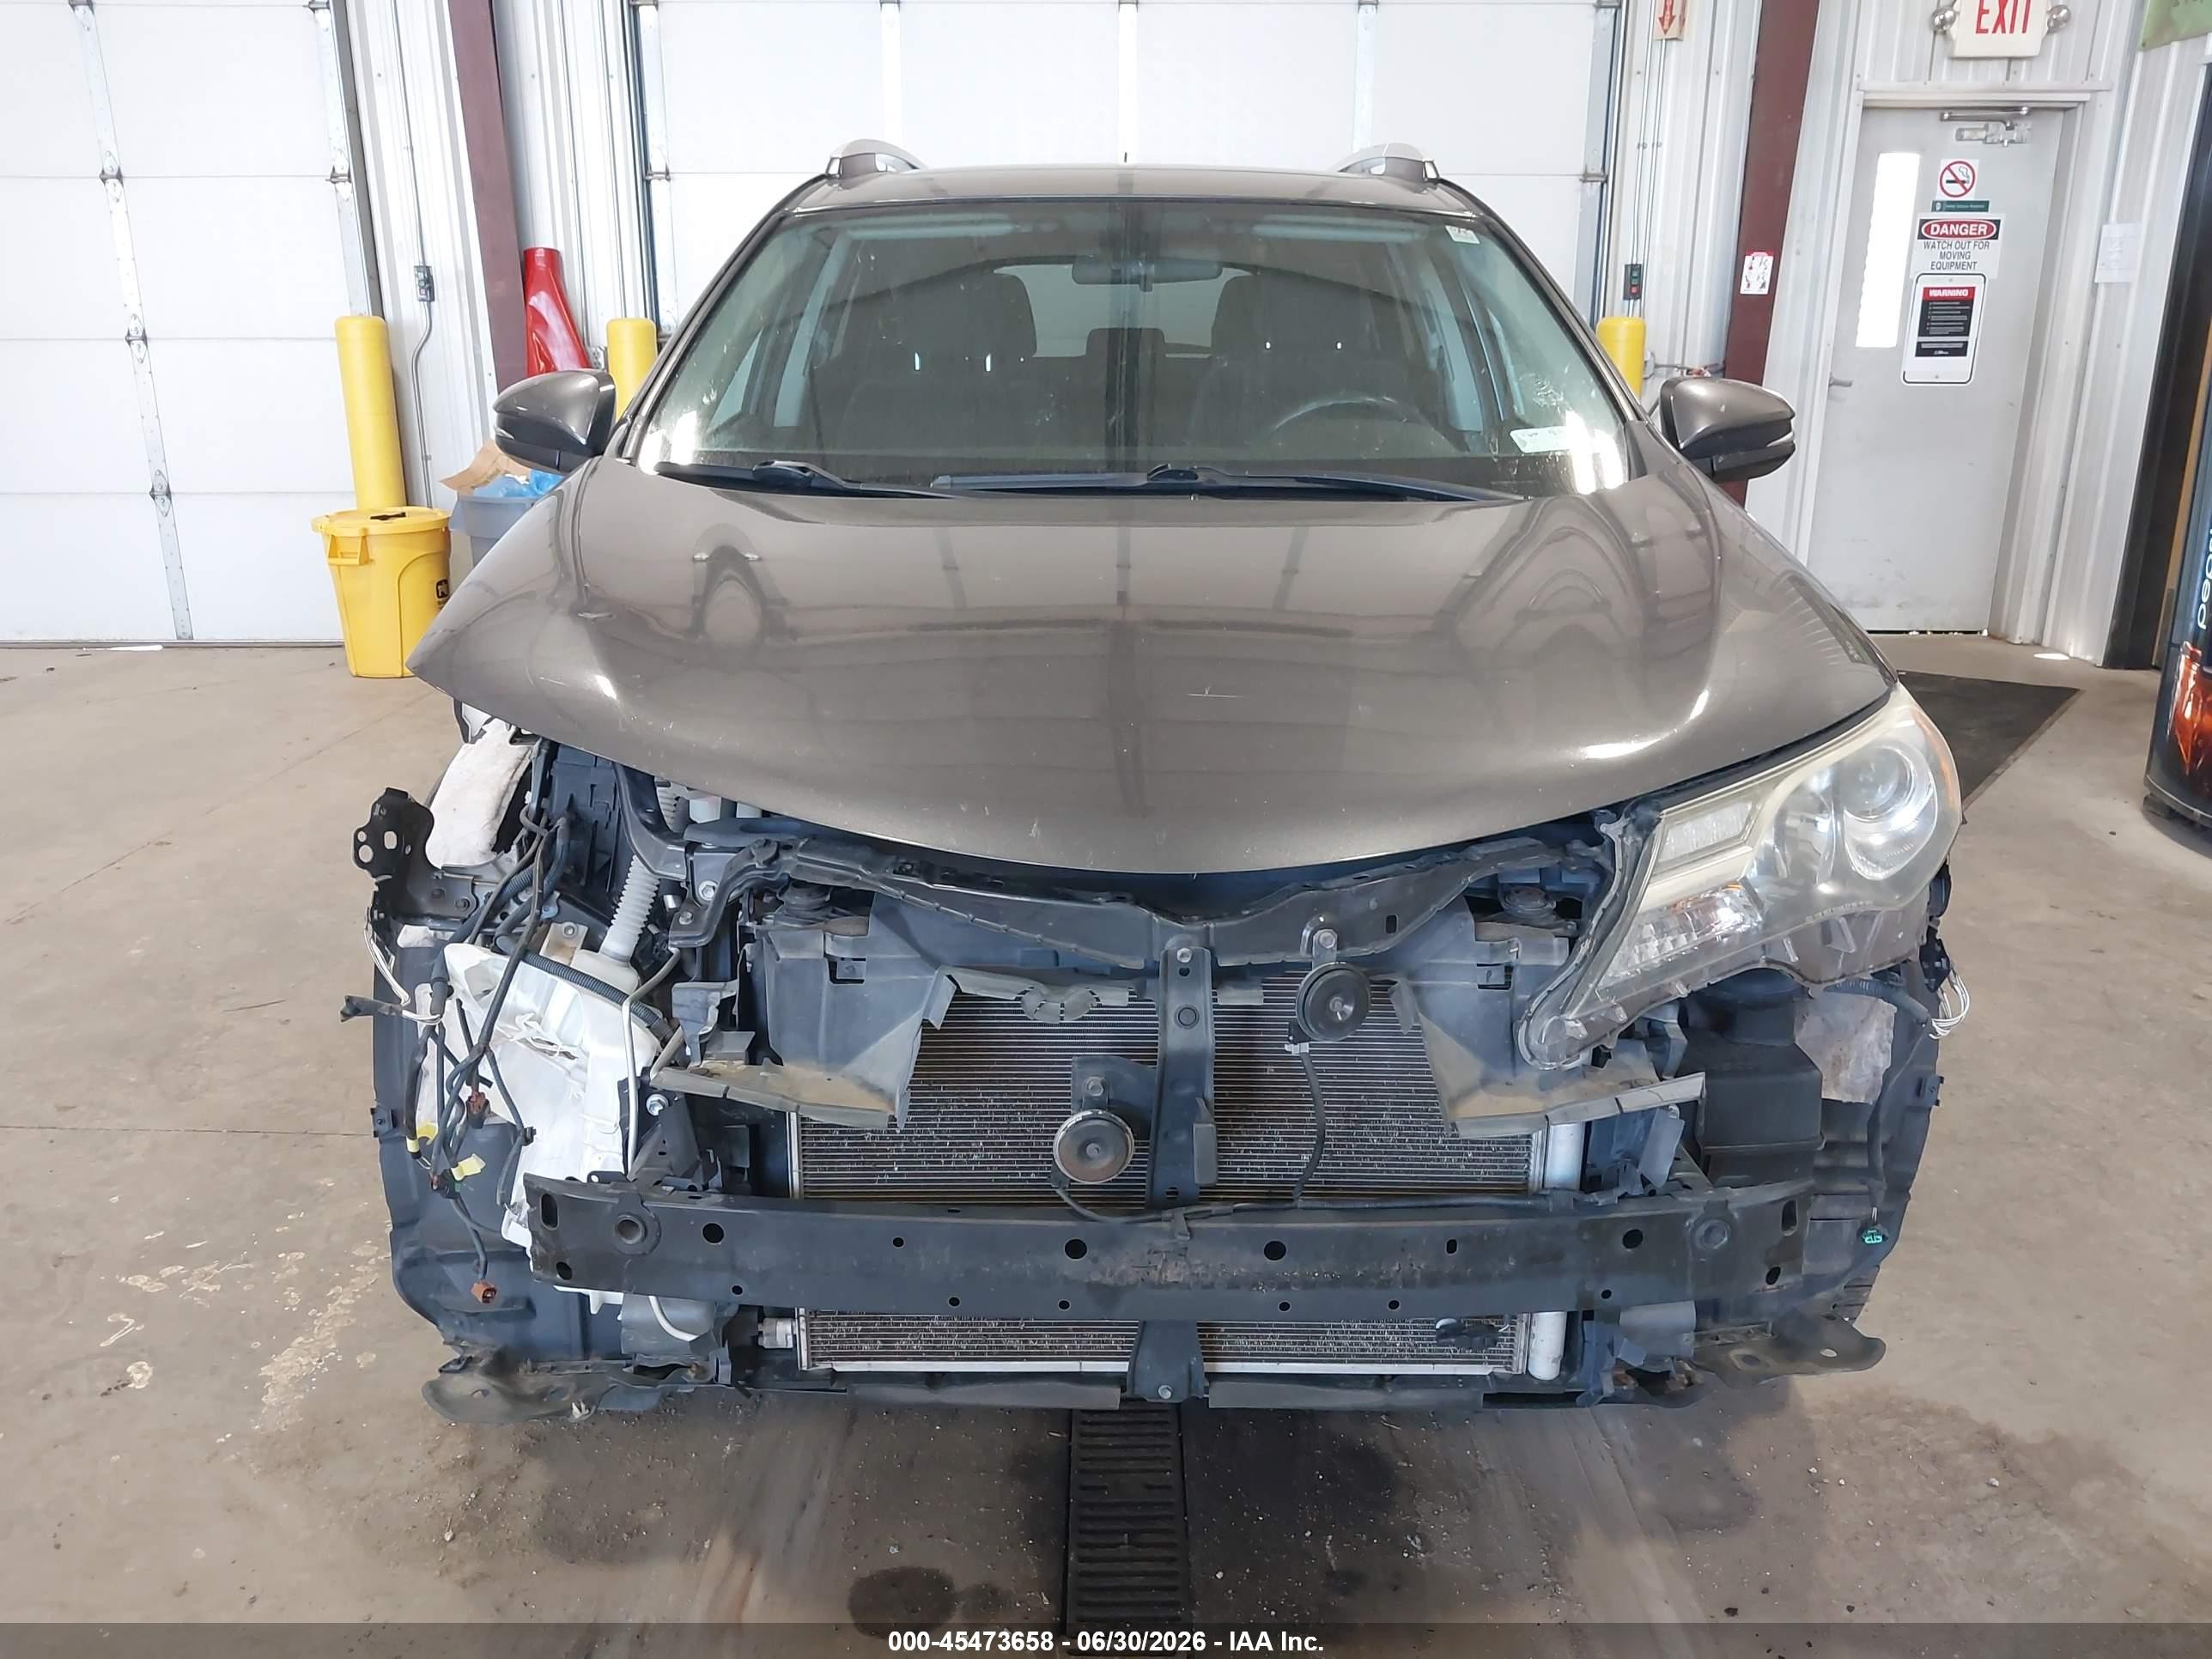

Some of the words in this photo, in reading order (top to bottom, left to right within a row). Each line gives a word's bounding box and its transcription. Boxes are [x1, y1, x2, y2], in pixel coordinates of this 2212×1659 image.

[1929, 223, 1988, 236] DANGER
[1923, 241, 1953, 250] WATCH
[1954, 241, 1972, 250] OUT
[1973, 241, 1990, 250] FOR
[1939, 251, 1971, 260] MOVING
[1930, 261, 1978, 270] EQUIPMENT
[1929, 289, 1969, 297] WARNING
